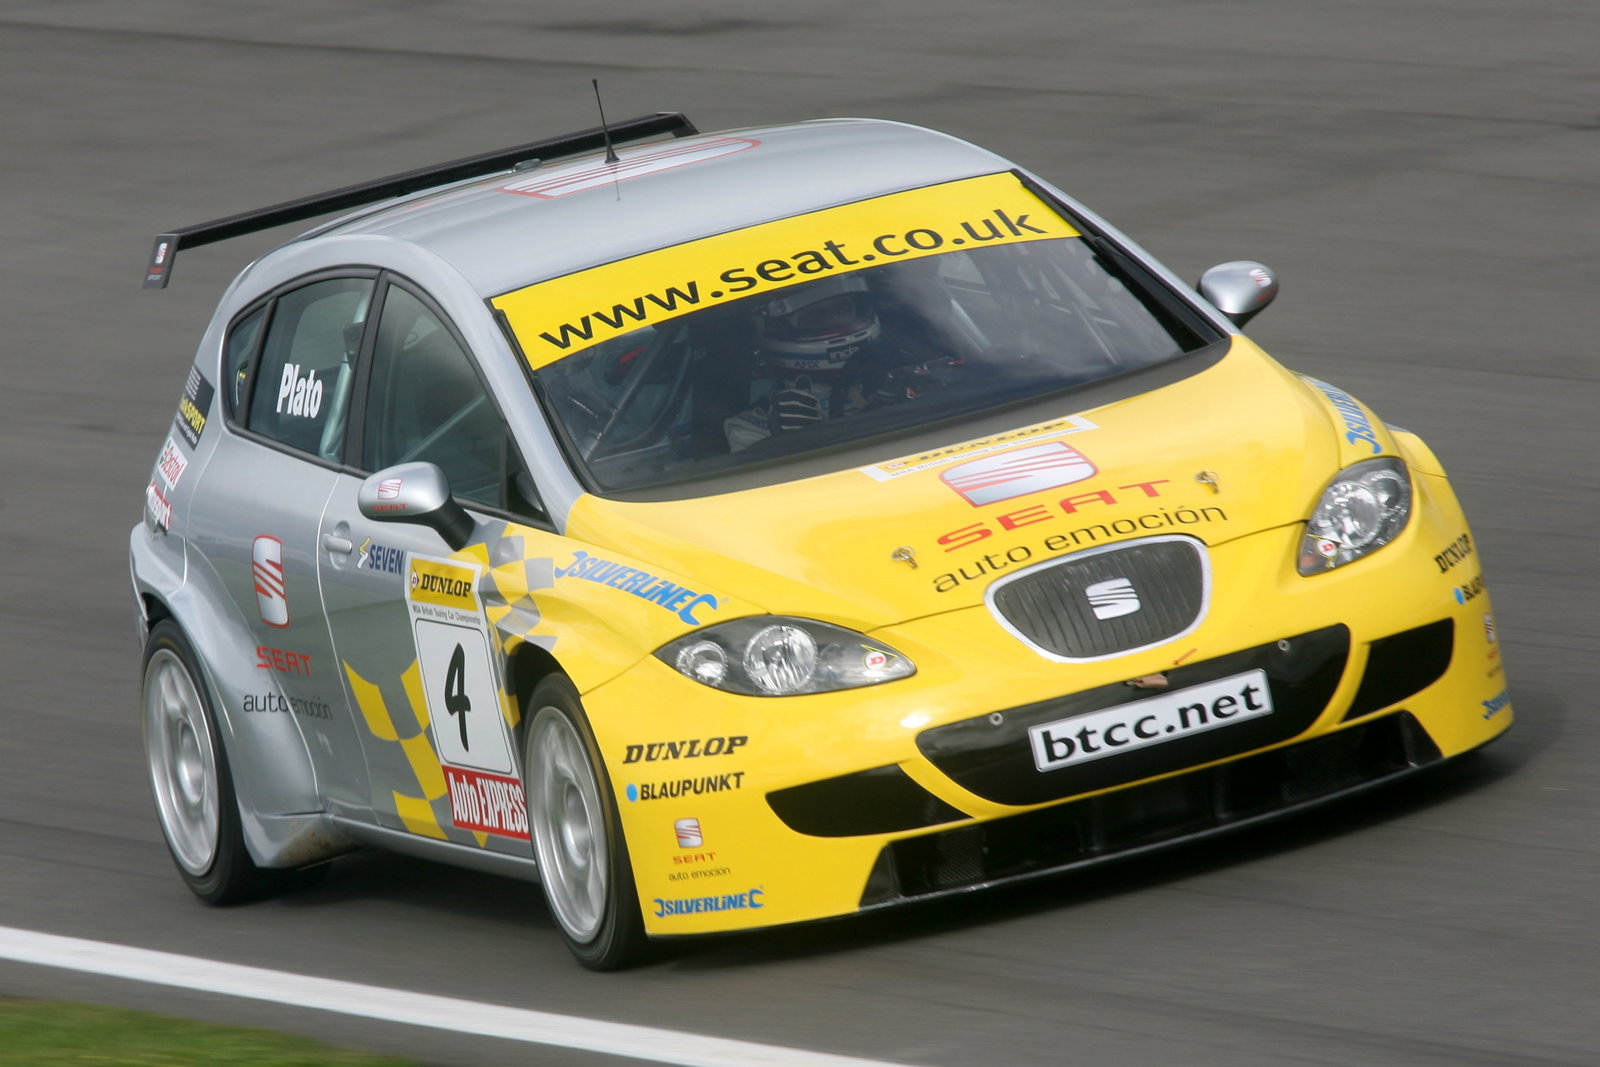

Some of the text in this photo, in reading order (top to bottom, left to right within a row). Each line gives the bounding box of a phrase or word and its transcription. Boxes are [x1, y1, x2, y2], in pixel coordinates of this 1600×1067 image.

[538, 208, 1048, 350] www.seat.co.uk
[276, 363, 322, 418] Plato
[936, 479, 1170, 552] SEAT
[368, 544, 404, 575] SEVEN
[933, 504, 1228, 593] auto emoción
[421, 574, 472, 597] DUNLOP
[256, 646, 312, 677] SEAT
[243, 691, 289, 713] auto
[445, 643, 471, 752] 4
[1042, 683, 1262, 763] btcc.net
[622, 736, 748, 764] DUNLOP
[640, 772, 745, 801] BLAUPUNKT
[448, 772, 530, 834] Auto EXPRESS
[669, 865, 731, 881] auto emoción
[672, 852, 716, 865] SEAT
